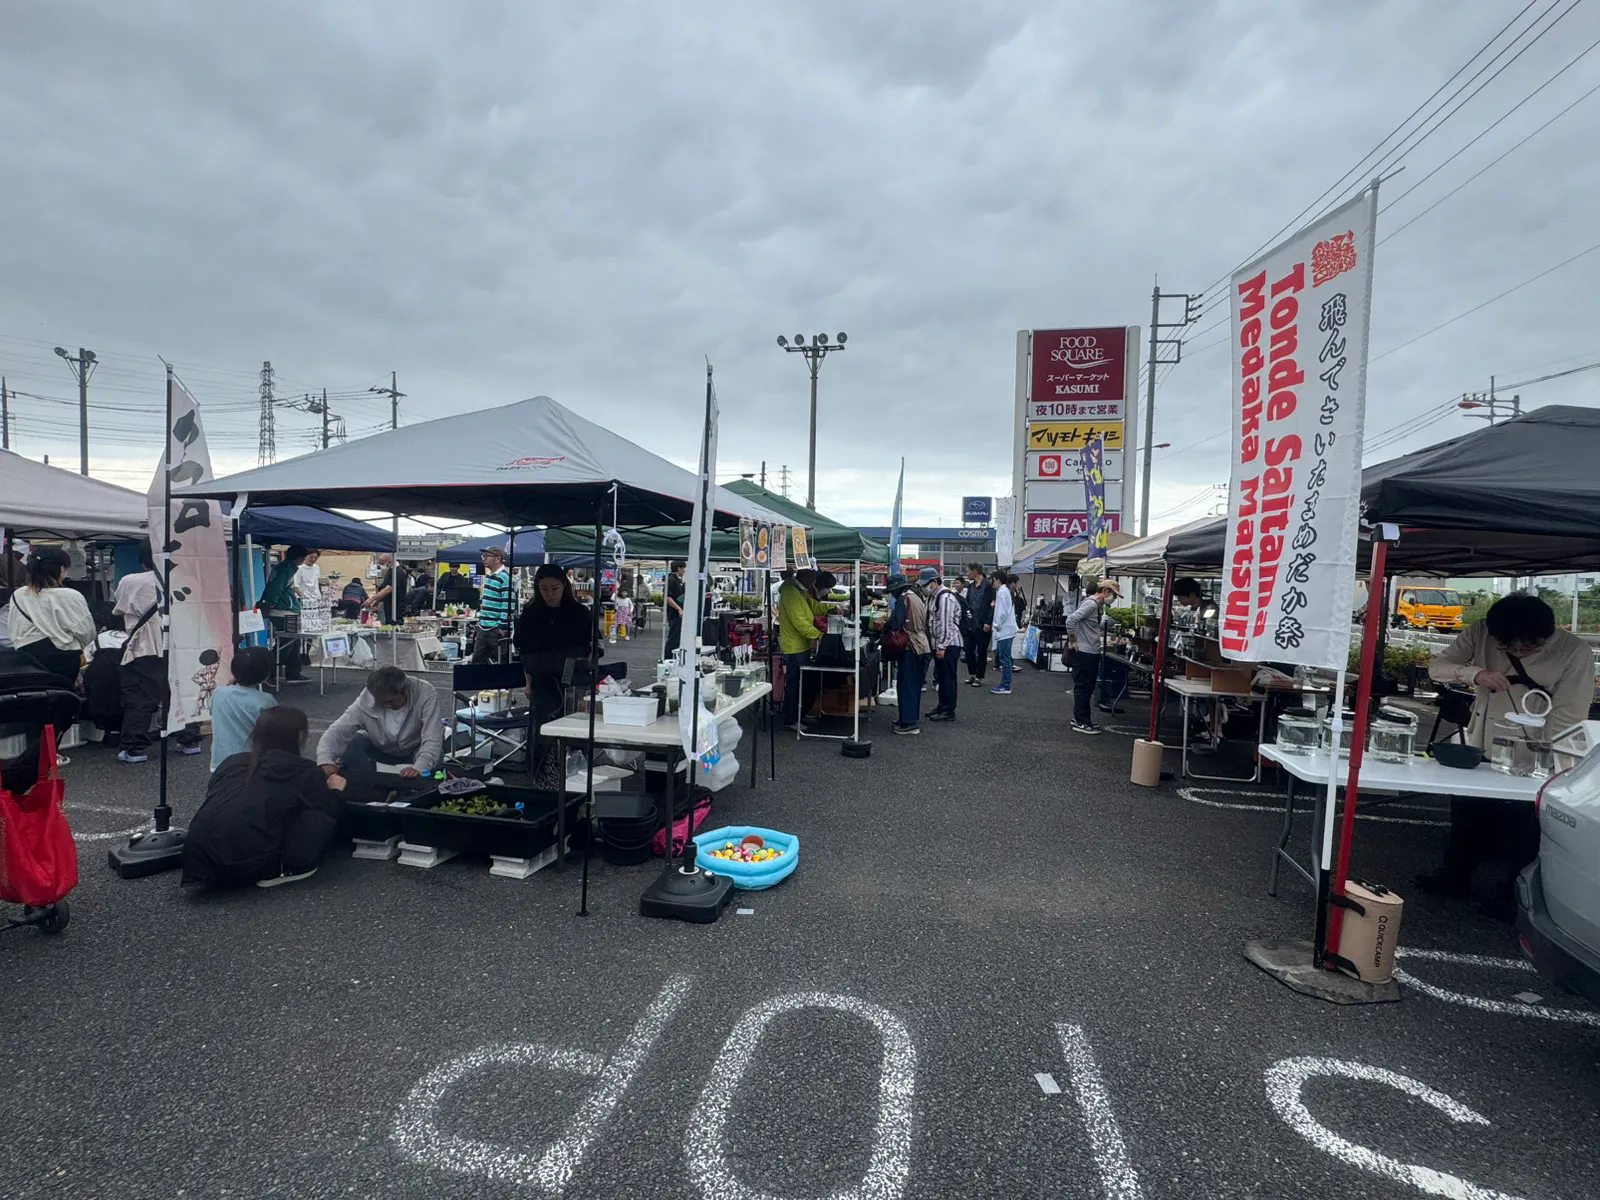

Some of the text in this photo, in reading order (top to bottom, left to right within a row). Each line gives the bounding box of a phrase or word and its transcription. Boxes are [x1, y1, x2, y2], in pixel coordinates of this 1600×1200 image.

[1059, 336, 1097, 349] FOOD
[1050, 348, 1106, 364] SQUARE
[1046, 373, 1110, 382] スーパーマーケット
[1055, 384, 1100, 395] KASUMI
[1035, 403, 1119, 416] 夜10時まで営業
[1252, 262, 1305, 638] Tonde Saitama
[1221, 270, 1266, 653] Medaka Matsuri
[1274, 292, 1347, 650] 飛んでさいたまめだか祭
